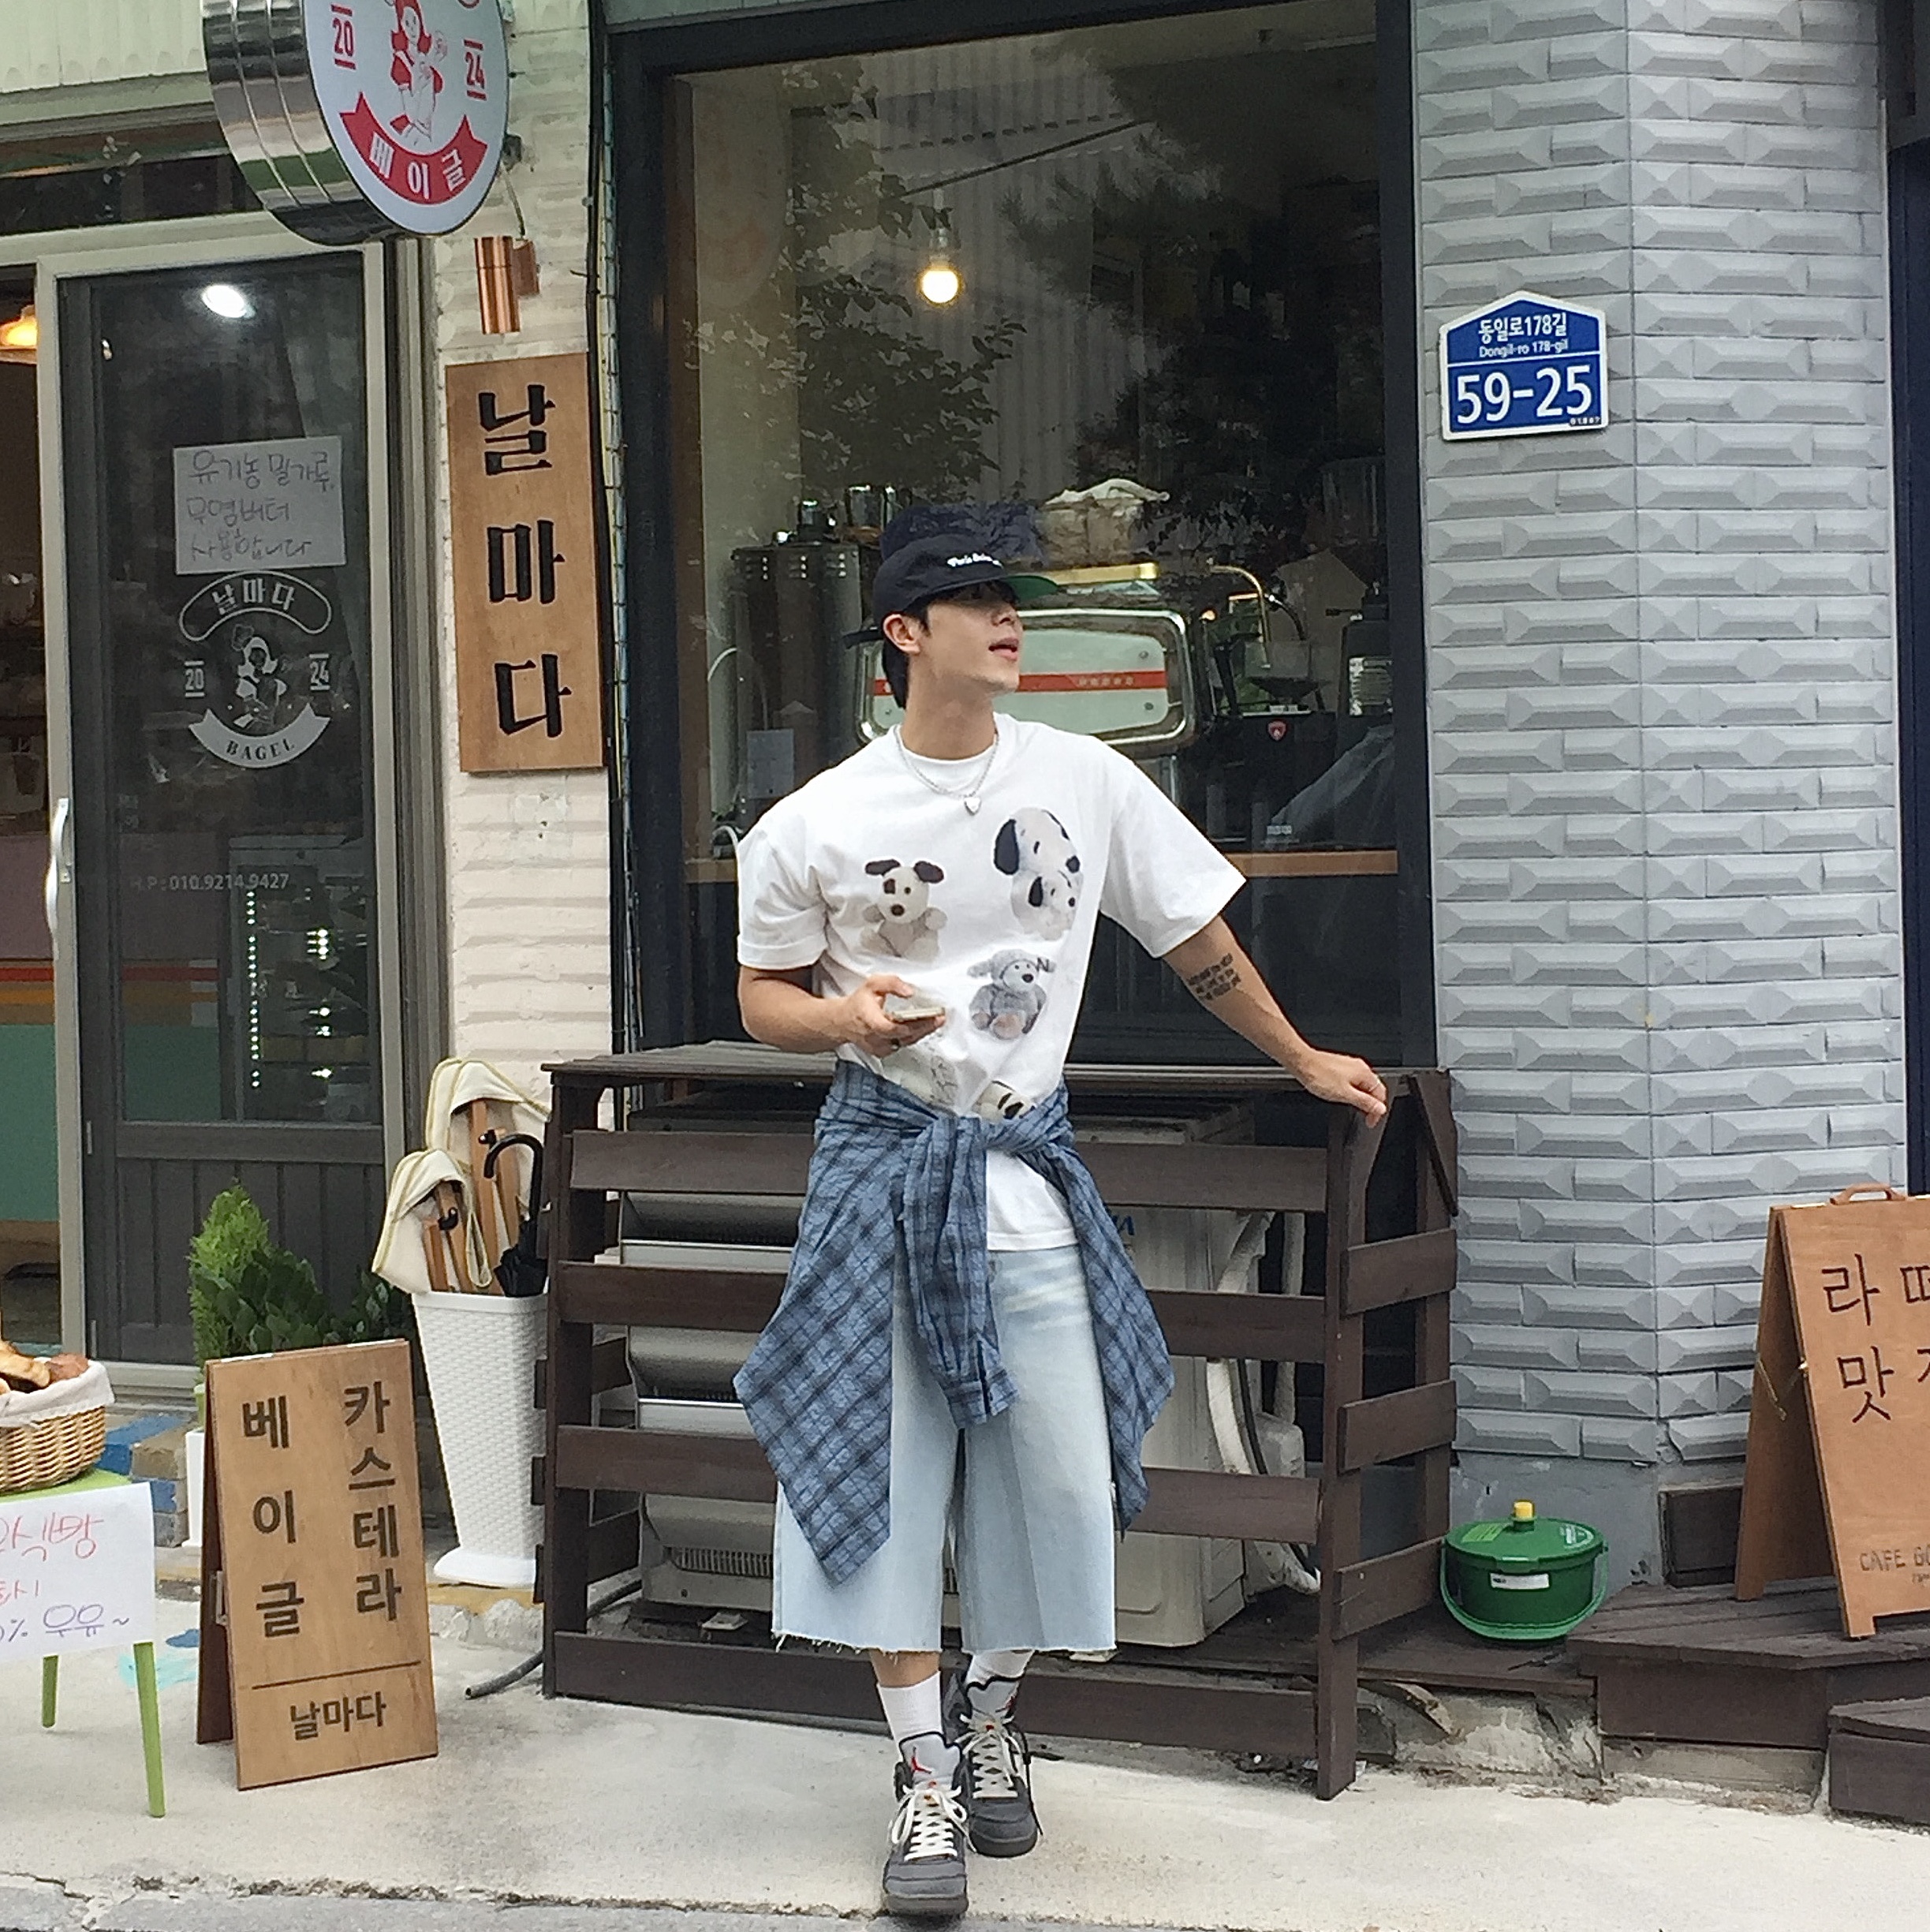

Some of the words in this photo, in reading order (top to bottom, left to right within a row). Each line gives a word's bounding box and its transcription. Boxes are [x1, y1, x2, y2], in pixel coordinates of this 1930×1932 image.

[333, 19, 357, 58] 20
[465, 52, 487, 90] 24
[369, 131, 467, 200] 베이글
[1478, 312, 1567, 344] 동일로178길
[1479, 343, 1530, 358] Dongil-ro
[1532, 338, 1568, 354] 178-gil
[1458, 364, 1592, 424] 59-25
[189, 449, 261, 490] 유기농
[478, 384, 573, 738] 날마다
[211, 577, 296, 616] 날마다
[185, 667, 206, 691] 20
[225, 738, 296, 761] BAGEL
[241, 1395, 305, 1639] 베이글
[342, 1381, 402, 1622] 카스테라
[1859, 1549, 1906, 1571] CAFE
[289, 1691, 387, 1741] 날마다
